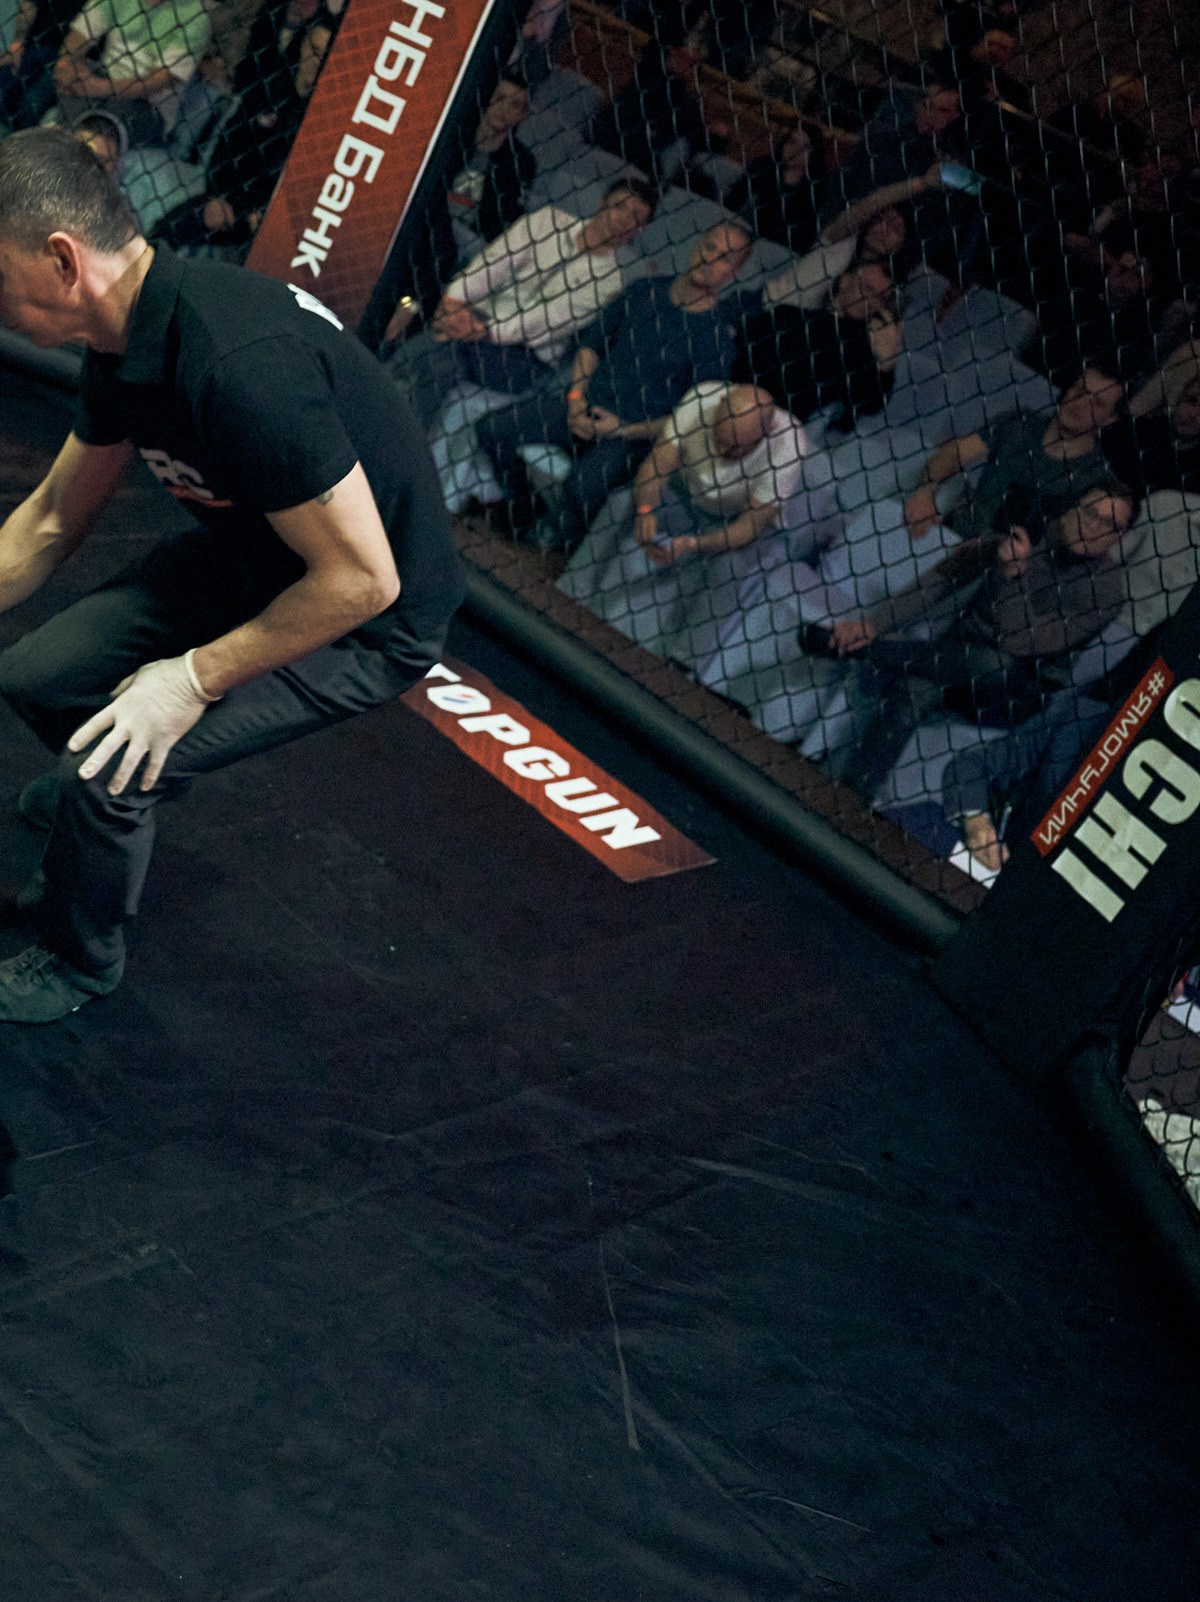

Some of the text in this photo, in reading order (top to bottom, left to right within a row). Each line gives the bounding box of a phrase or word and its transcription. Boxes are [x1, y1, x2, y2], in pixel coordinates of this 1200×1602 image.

[352, 0, 446, 135] НБД
[290, 134, 385, 278] Банк
[1039, 671, 1166, 846] #ЯМОГУЧИЙ
